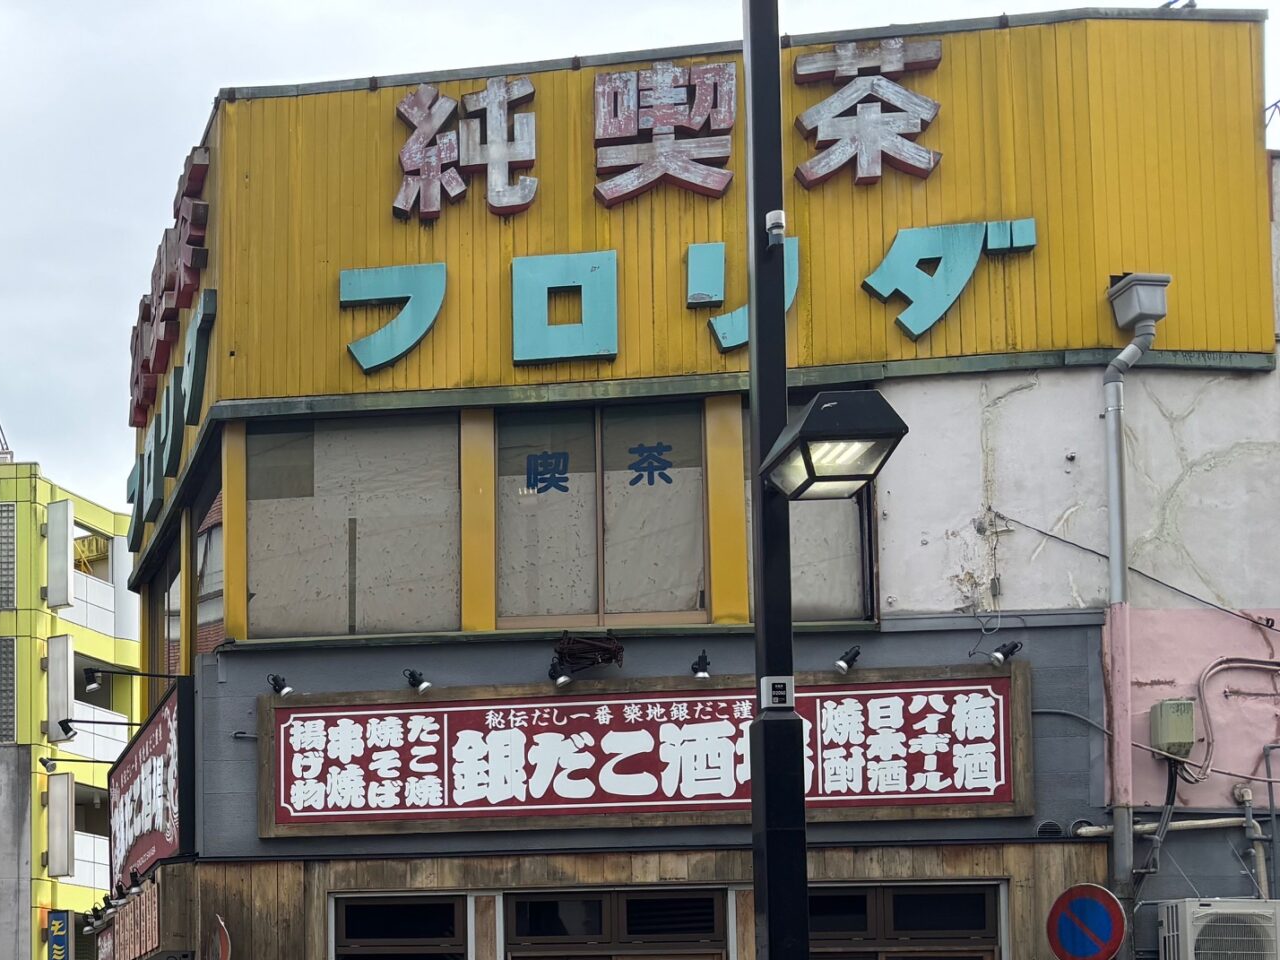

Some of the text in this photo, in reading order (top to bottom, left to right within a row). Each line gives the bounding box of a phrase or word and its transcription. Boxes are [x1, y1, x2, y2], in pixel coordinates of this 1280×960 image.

[392, 38, 942, 221] 純喫茶
[339, 218, 1038, 375] フロリダ
[527, 442, 673, 494] 喫茶
[366, 716, 404, 808] 焼そば
[404, 715, 443, 807] たこ焼
[452, 719, 814, 806] 銀だこ酒
[485, 705, 613, 729] 秘伝だし一番
[821, 698, 865, 794] 焼酎
[866, 696, 907, 793] 日本酒
[908, 694, 952, 791] ハイボール
[952, 693, 996, 790] 梅酒
[289, 719, 327, 810] 揚げ物
[326, 718, 366, 809] 串焼
